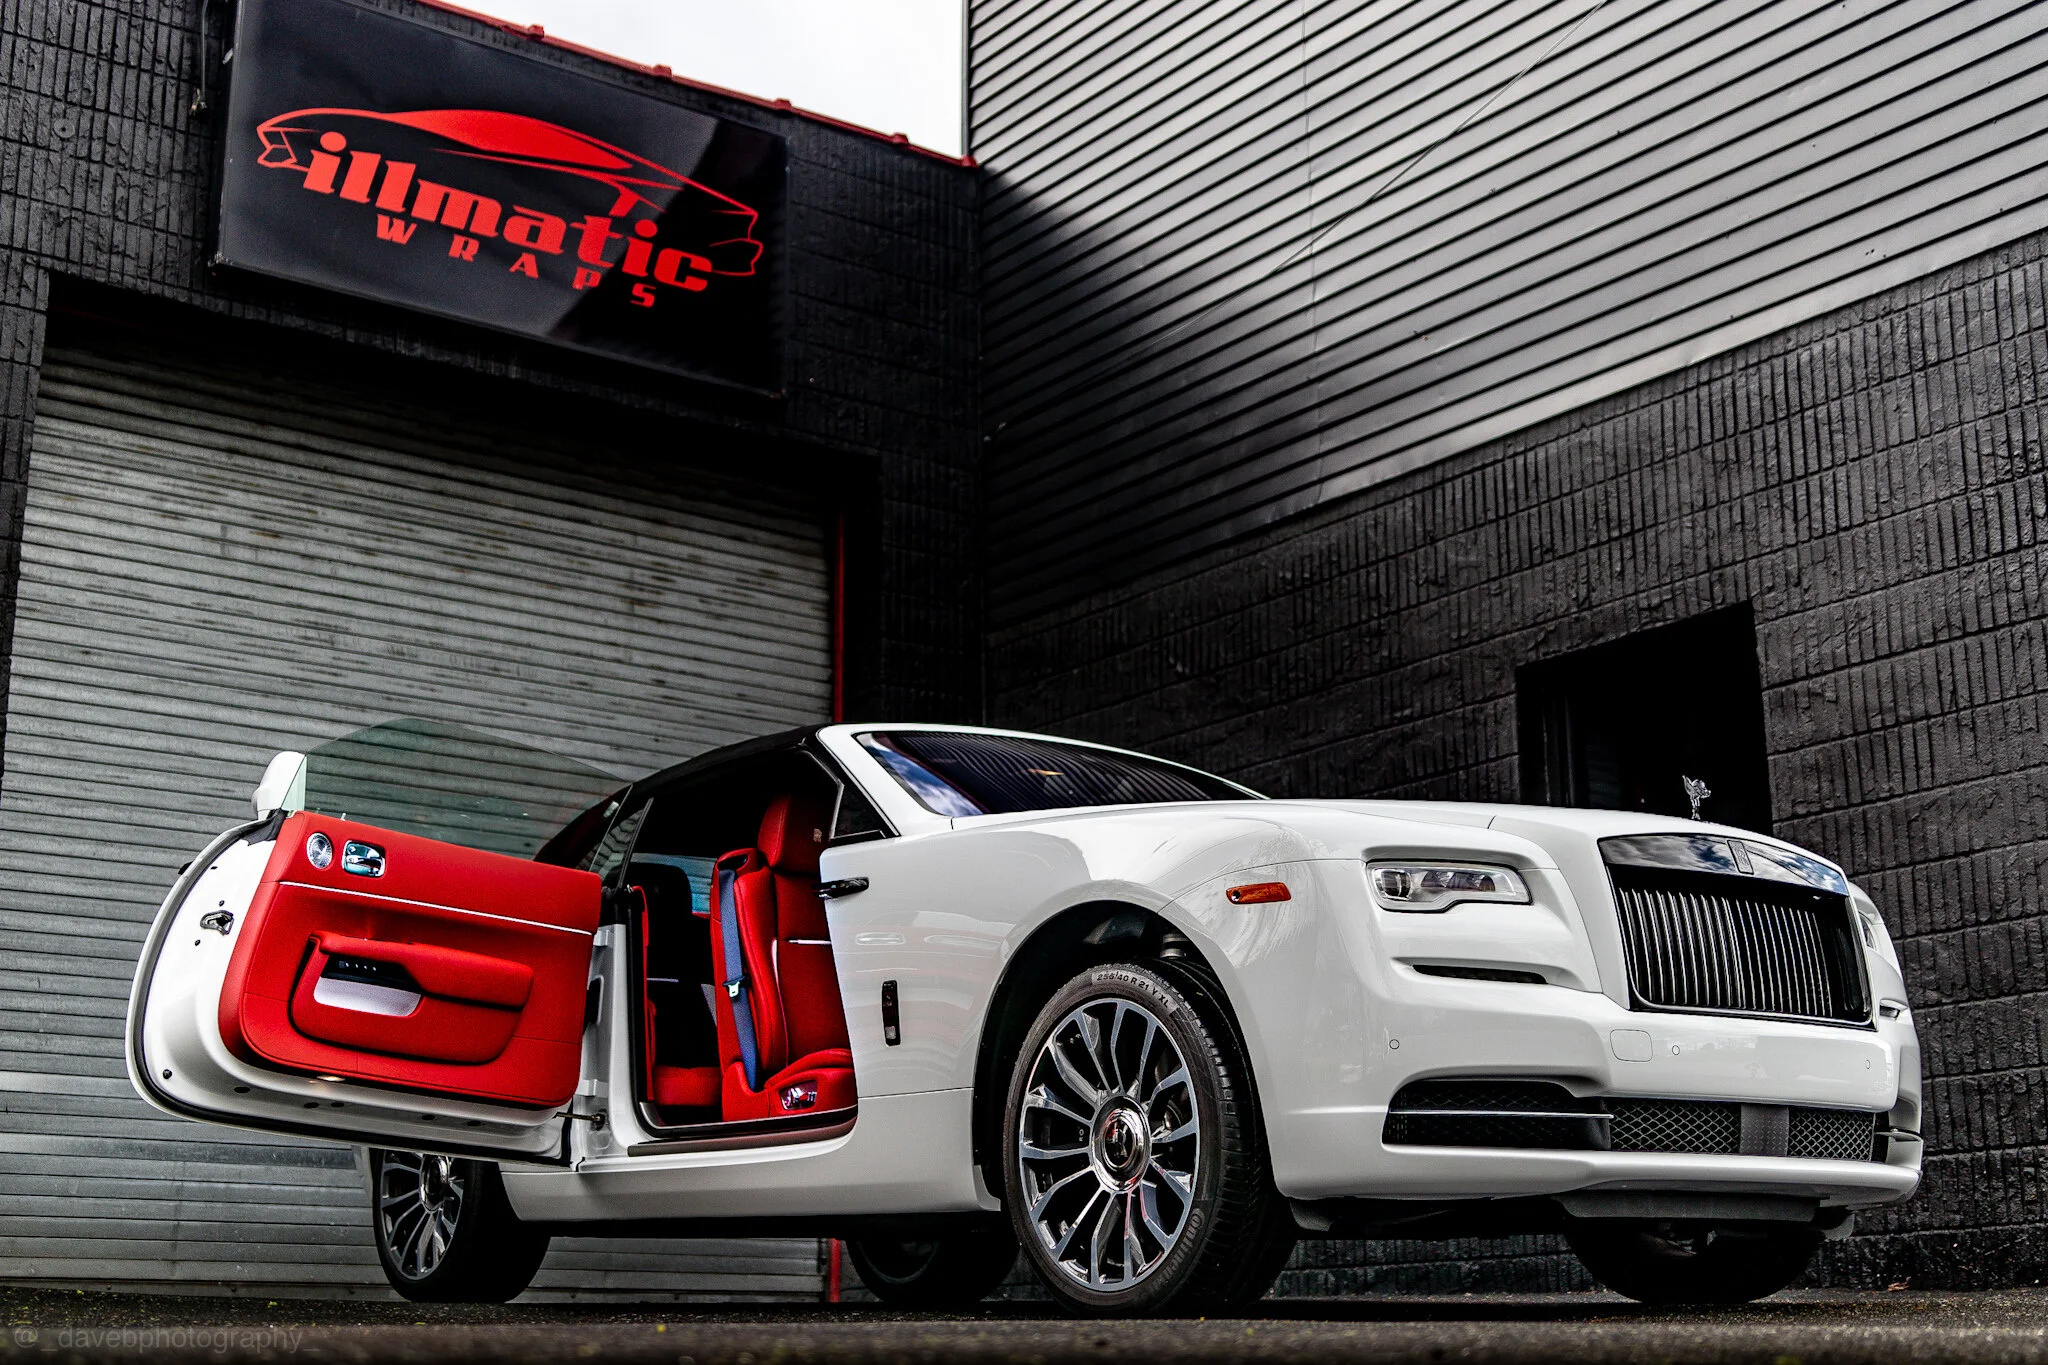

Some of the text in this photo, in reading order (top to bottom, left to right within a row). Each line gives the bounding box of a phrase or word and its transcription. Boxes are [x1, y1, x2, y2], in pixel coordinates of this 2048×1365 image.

[303, 131, 712, 292] illmatic
[376, 214, 656, 308] WRAPS
[1130, 976, 1138, 985] R
[1138, 980, 1150, 991] 21
[1158, 994, 1169, 1008] XL
